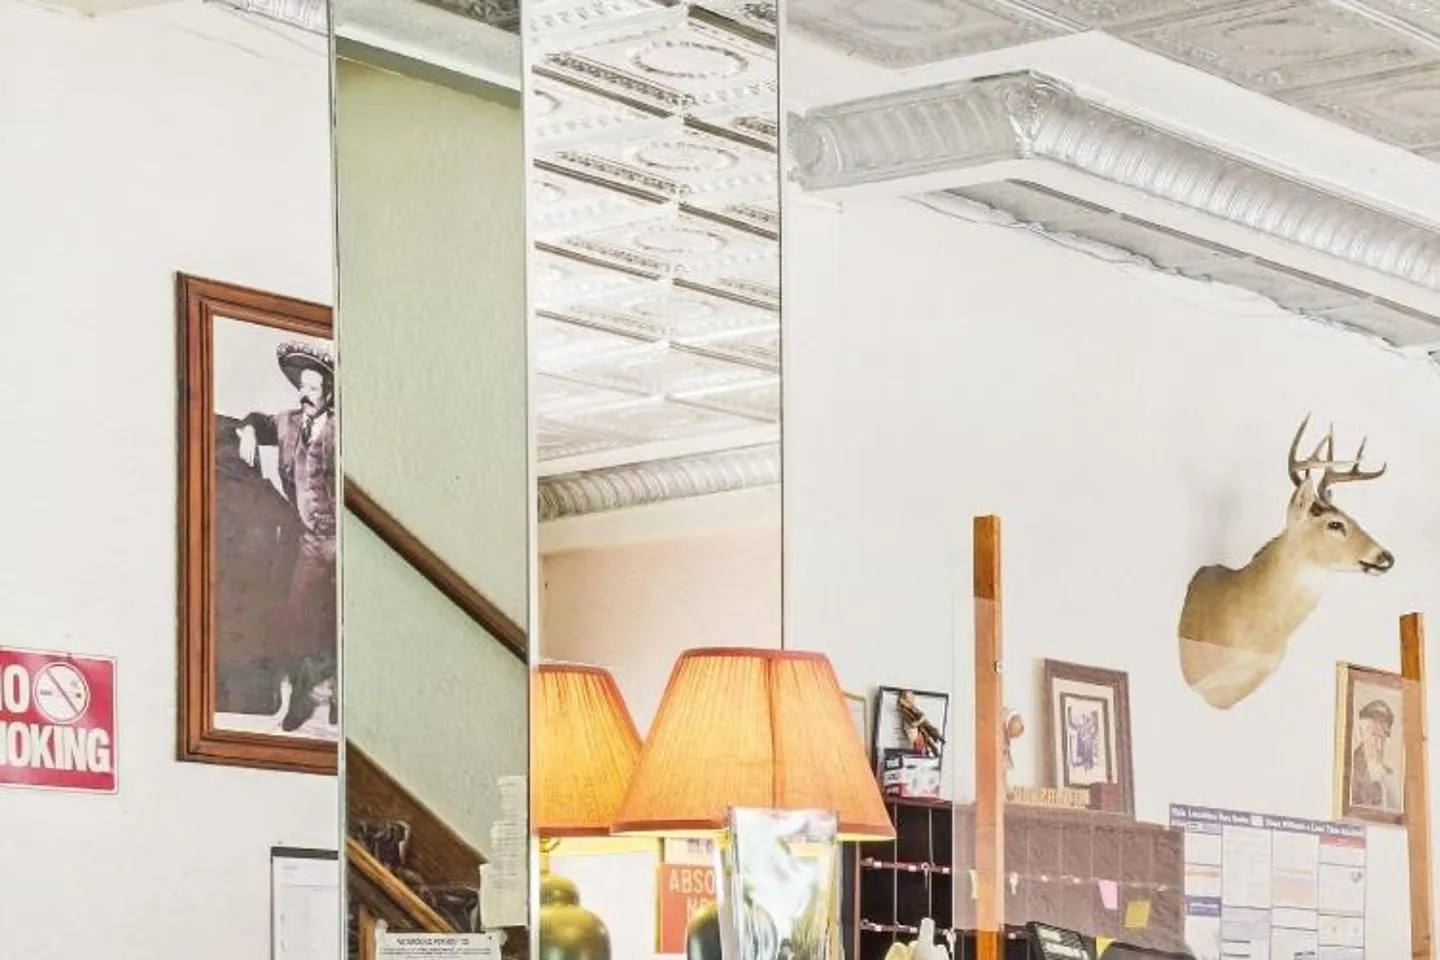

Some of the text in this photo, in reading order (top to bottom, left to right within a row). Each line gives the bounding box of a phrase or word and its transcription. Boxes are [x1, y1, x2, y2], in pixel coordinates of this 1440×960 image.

[0, 664, 30, 713] O
[0, 721, 111, 772] OKING
[669, 867, 717, 894] ABSO
